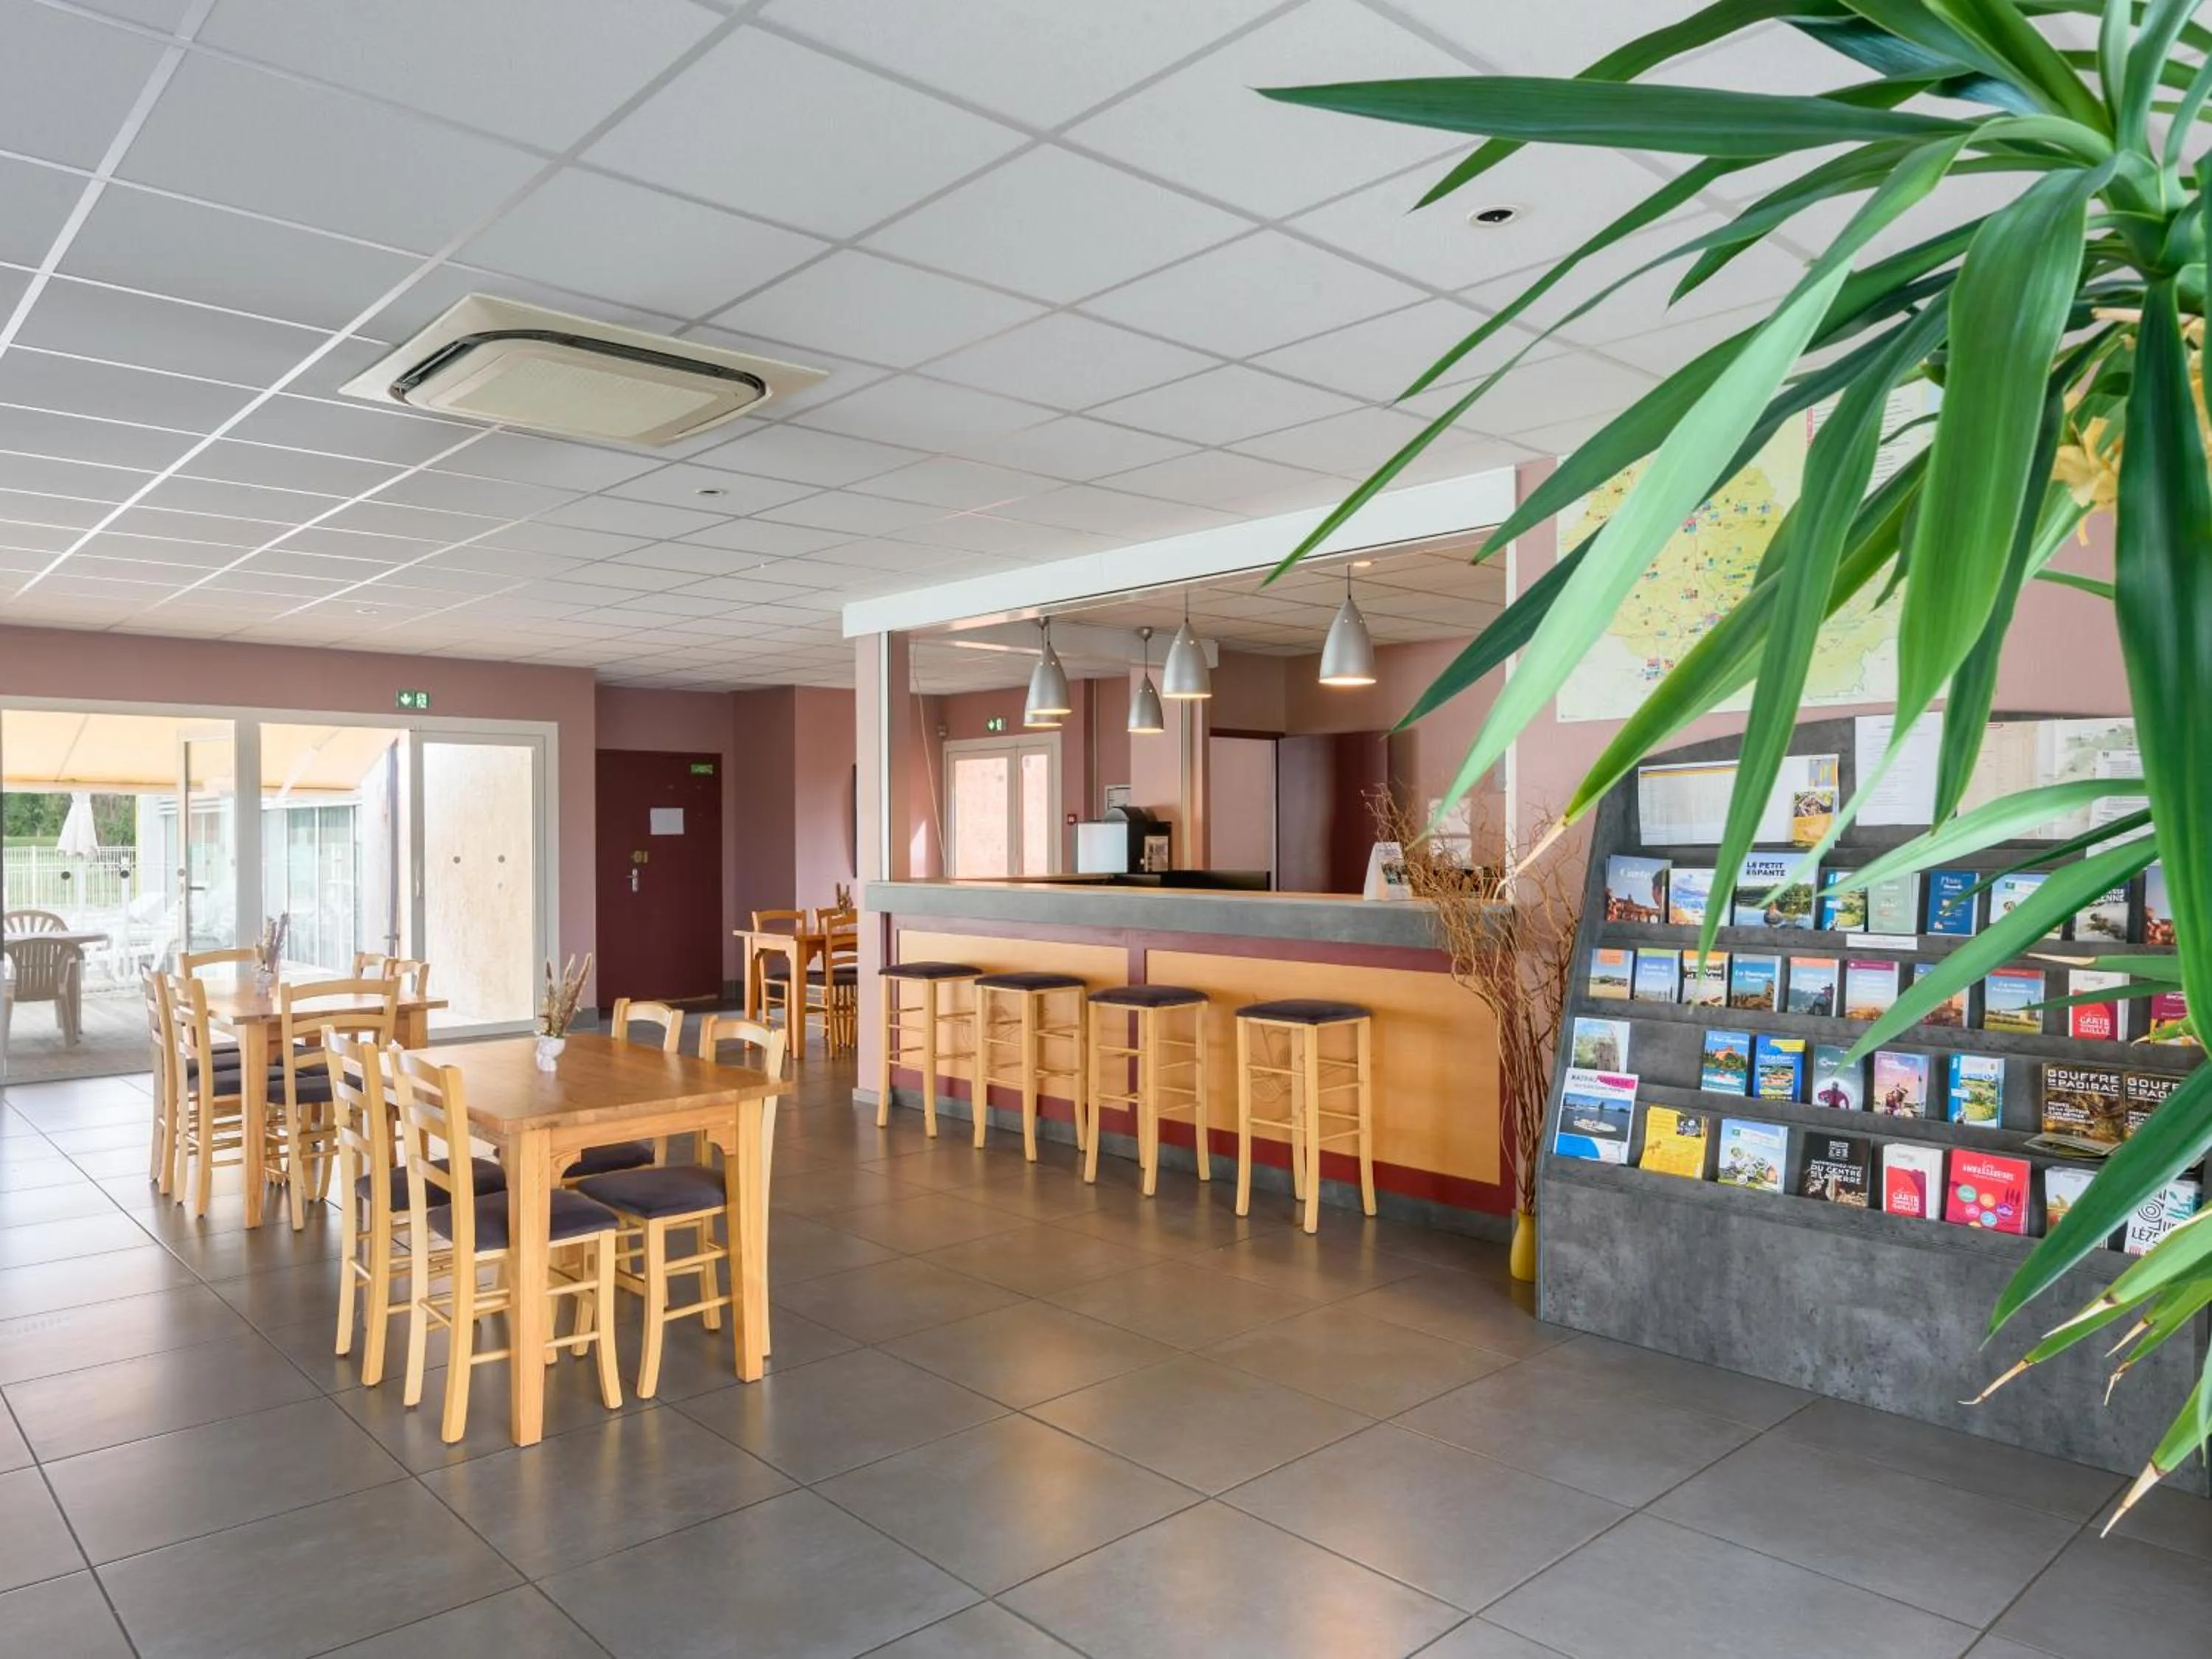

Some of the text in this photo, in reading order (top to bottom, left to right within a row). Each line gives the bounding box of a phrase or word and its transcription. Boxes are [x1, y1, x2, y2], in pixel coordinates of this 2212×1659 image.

[2048, 1068, 2120, 1085] GOUFFRE
[2058, 1079, 2120, 1093] PADIRAC
[2127, 1077, 2180, 1091] GOUFF
[1827, 1166, 1861, 1178] CENTRE
